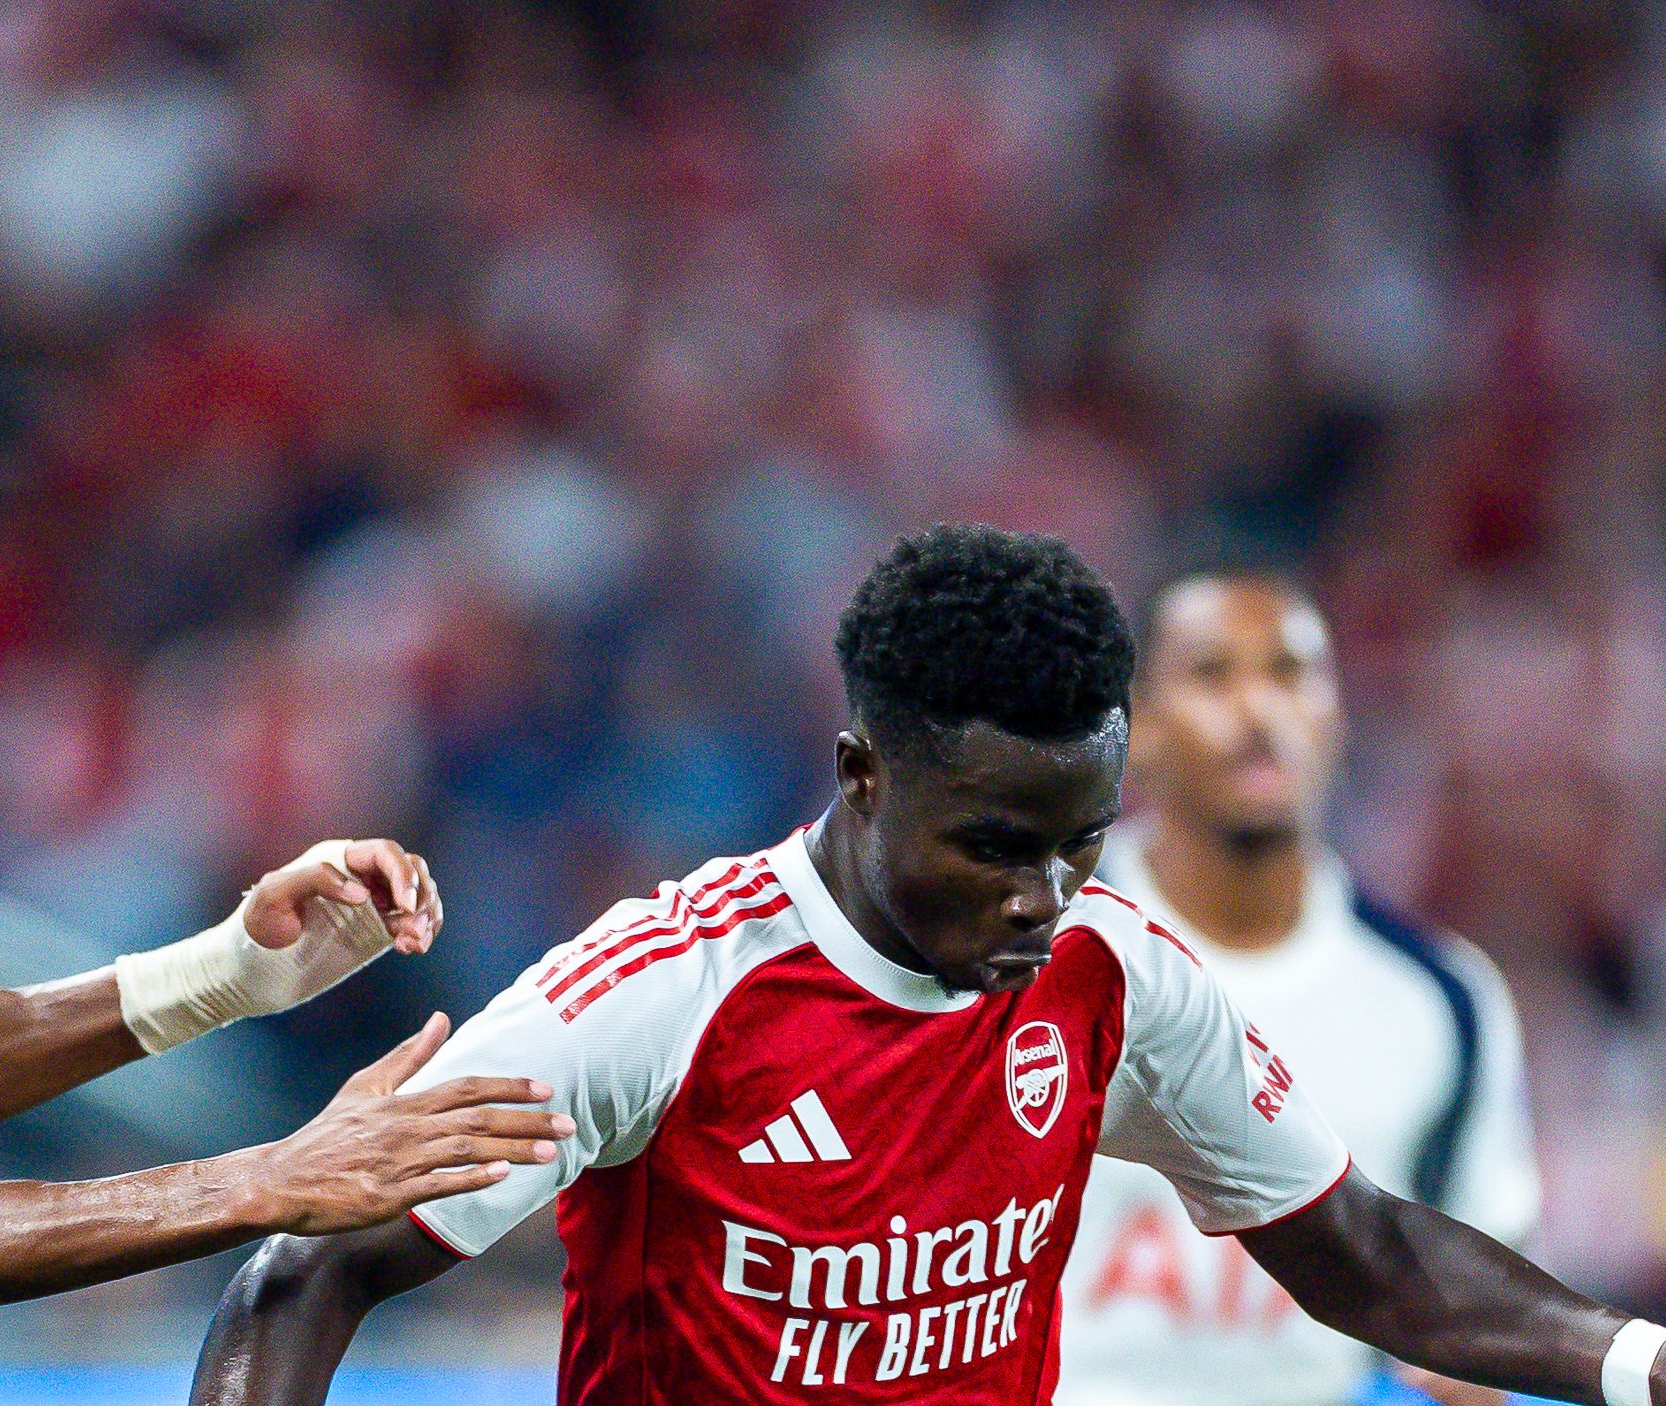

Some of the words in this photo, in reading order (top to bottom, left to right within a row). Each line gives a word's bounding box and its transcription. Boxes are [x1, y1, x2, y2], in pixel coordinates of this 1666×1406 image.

[1014, 1038, 1058, 1067] Arsenal
[721, 1183, 1066, 1309] Emirate
[770, 1318, 870, 1386] FLY
[874, 1279, 1027, 1382] BETTER
